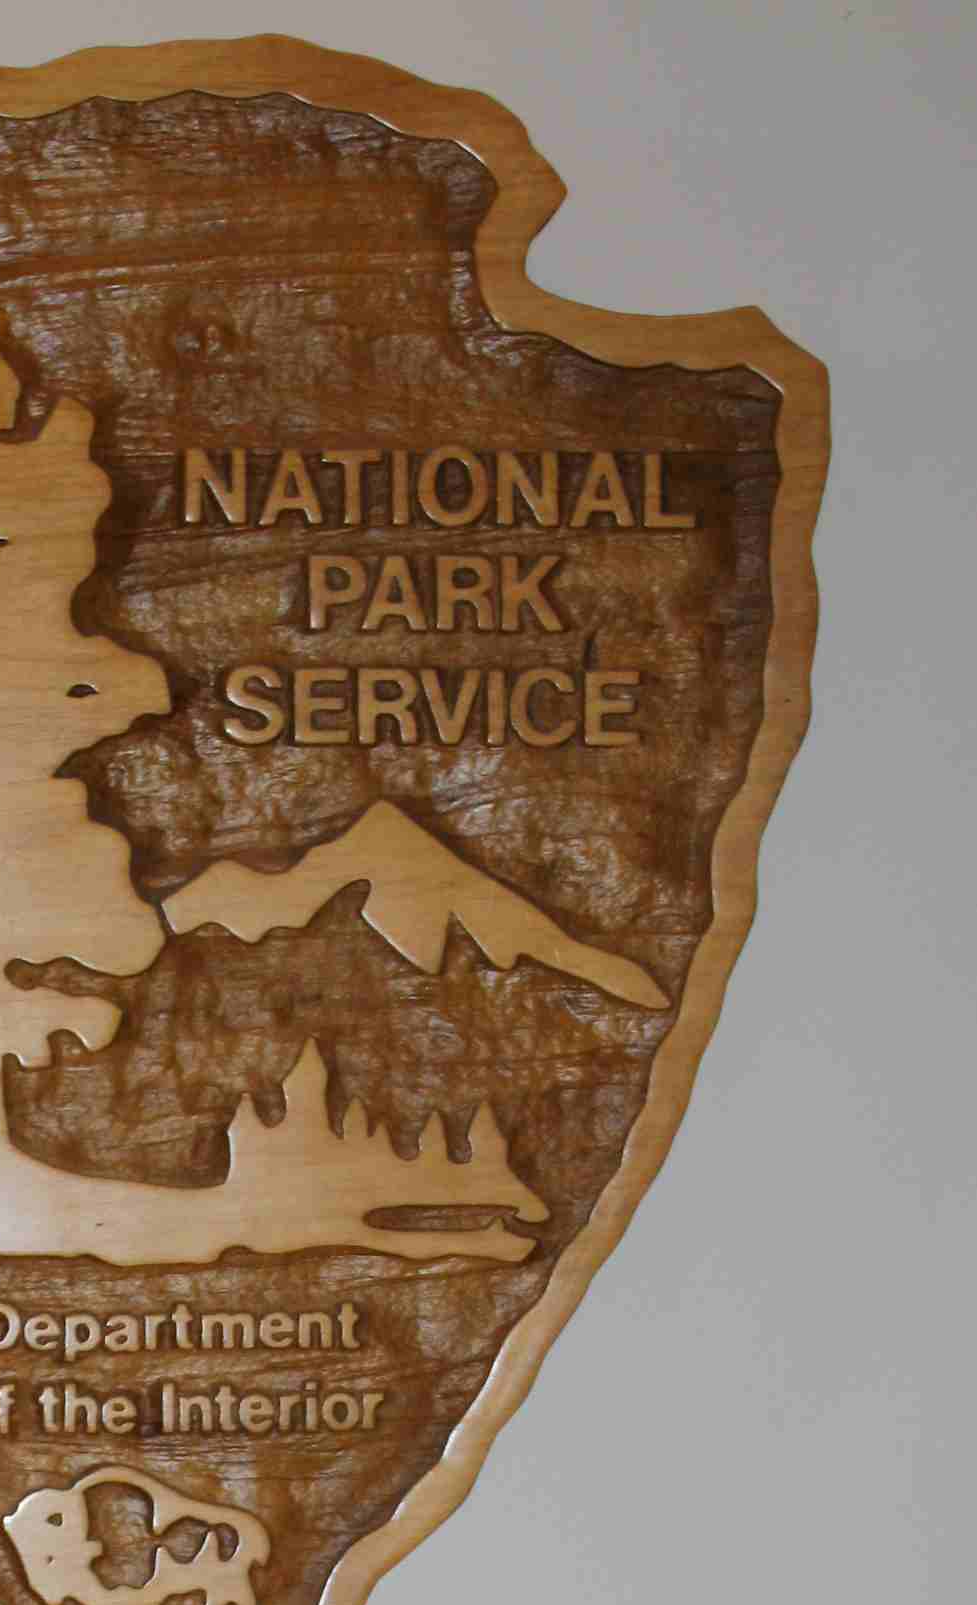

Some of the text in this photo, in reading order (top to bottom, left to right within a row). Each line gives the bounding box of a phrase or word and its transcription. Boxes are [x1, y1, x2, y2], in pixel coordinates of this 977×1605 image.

[182, 444, 697, 528] NATIONAL
[306, 554, 564, 633] PARK
[223, 664, 642, 747] SERVICE
[38, 1383, 138, 1435] the
[161, 1382, 385, 1434] Interior
